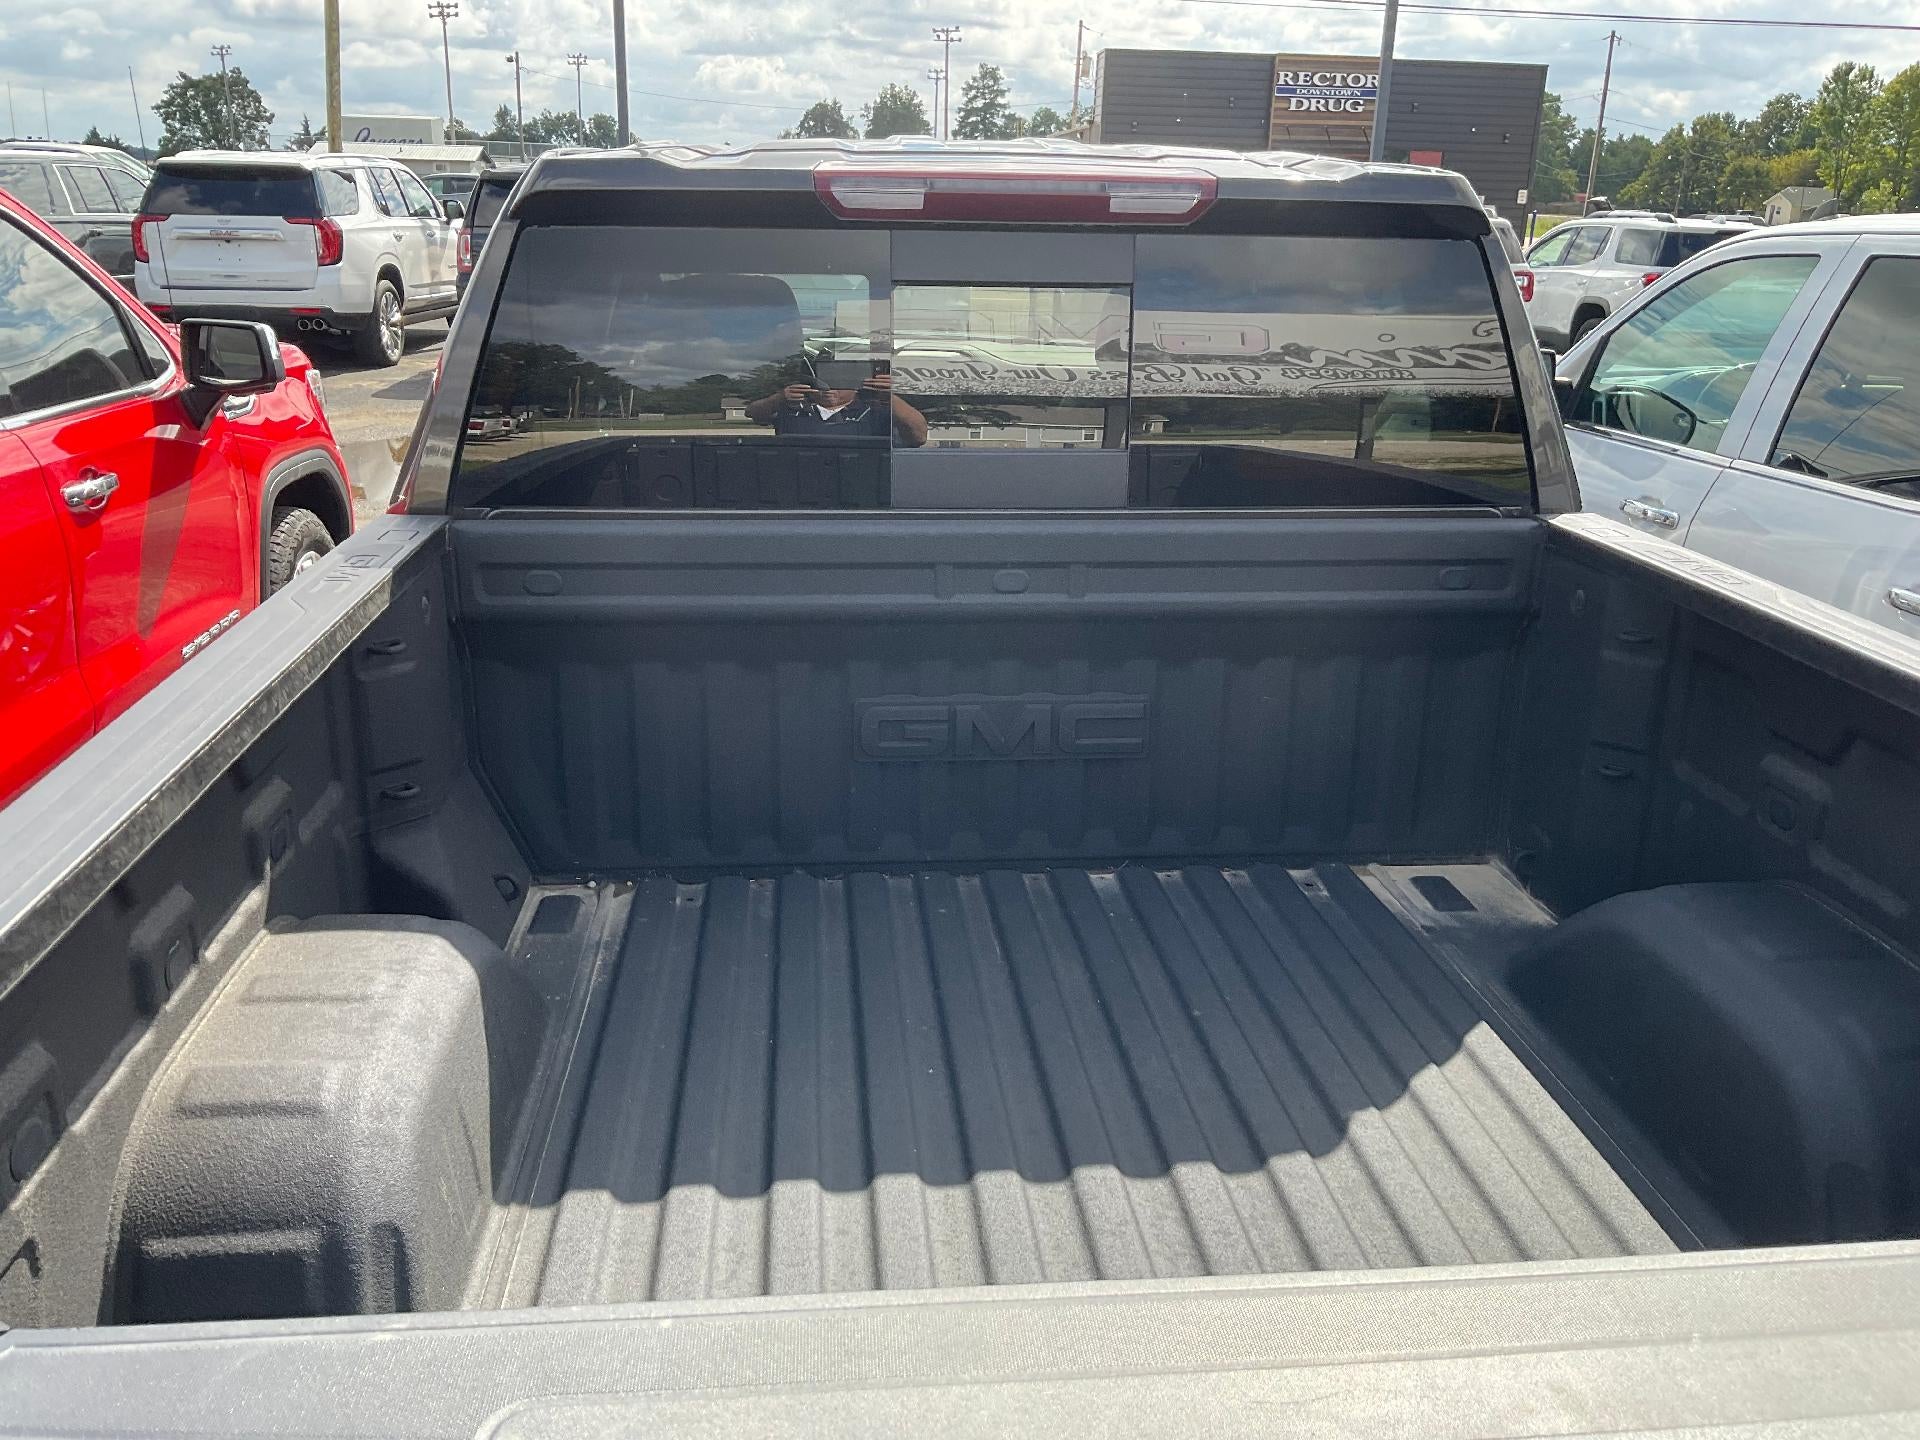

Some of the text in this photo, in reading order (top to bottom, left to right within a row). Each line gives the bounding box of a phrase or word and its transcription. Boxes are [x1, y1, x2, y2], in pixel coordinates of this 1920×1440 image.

[1276, 71, 1380, 88] RECTOR
[1296, 88, 1361, 97] DOWNTOWN
[1287, 97, 1365, 113] DRUG
[209, 229, 241, 237] GMC
[181, 609, 241, 661] SIERRA
[860, 702, 1147, 757] GMC
